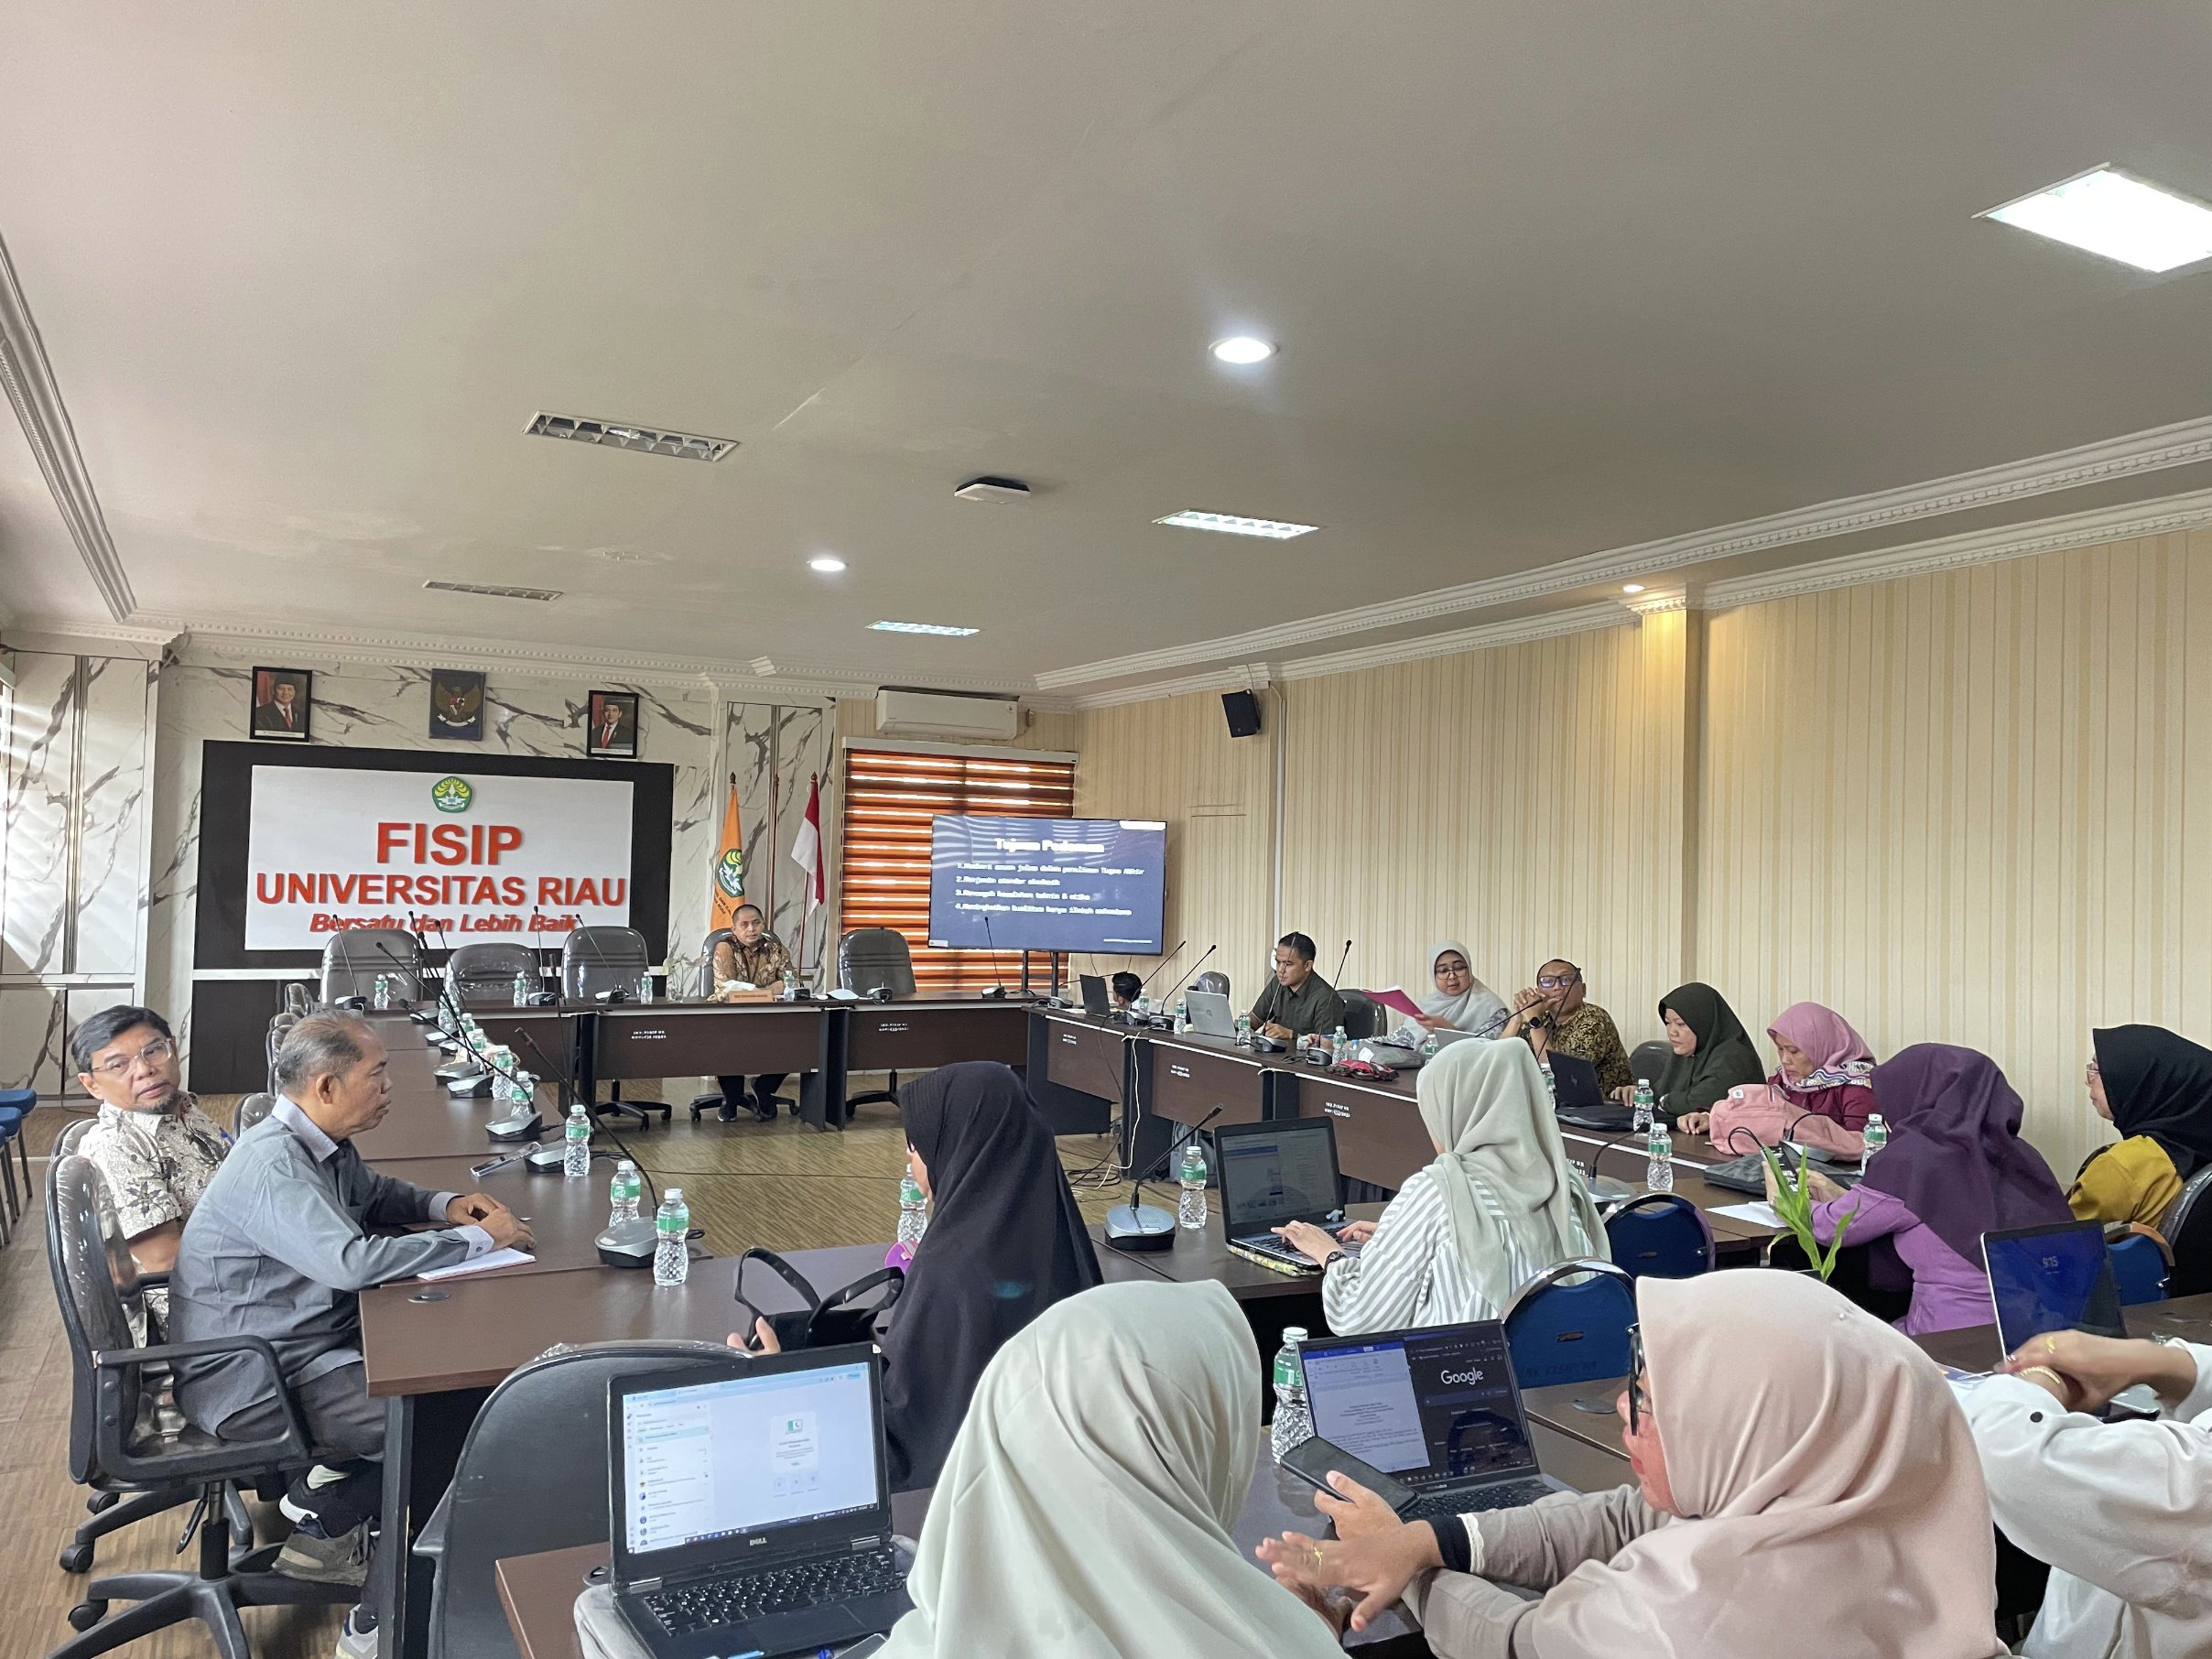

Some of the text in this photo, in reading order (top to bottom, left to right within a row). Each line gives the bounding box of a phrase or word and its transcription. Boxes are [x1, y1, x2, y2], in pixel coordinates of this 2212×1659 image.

[376, 822, 525, 866] FISIP
[256, 873, 627, 906] UNIVERSITAS RIAU
[309, 913, 579, 933] Bersatu dan Lebih Baik
[1440, 1366, 1484, 1385] Google
[749, 1536, 767, 1546] DELL
